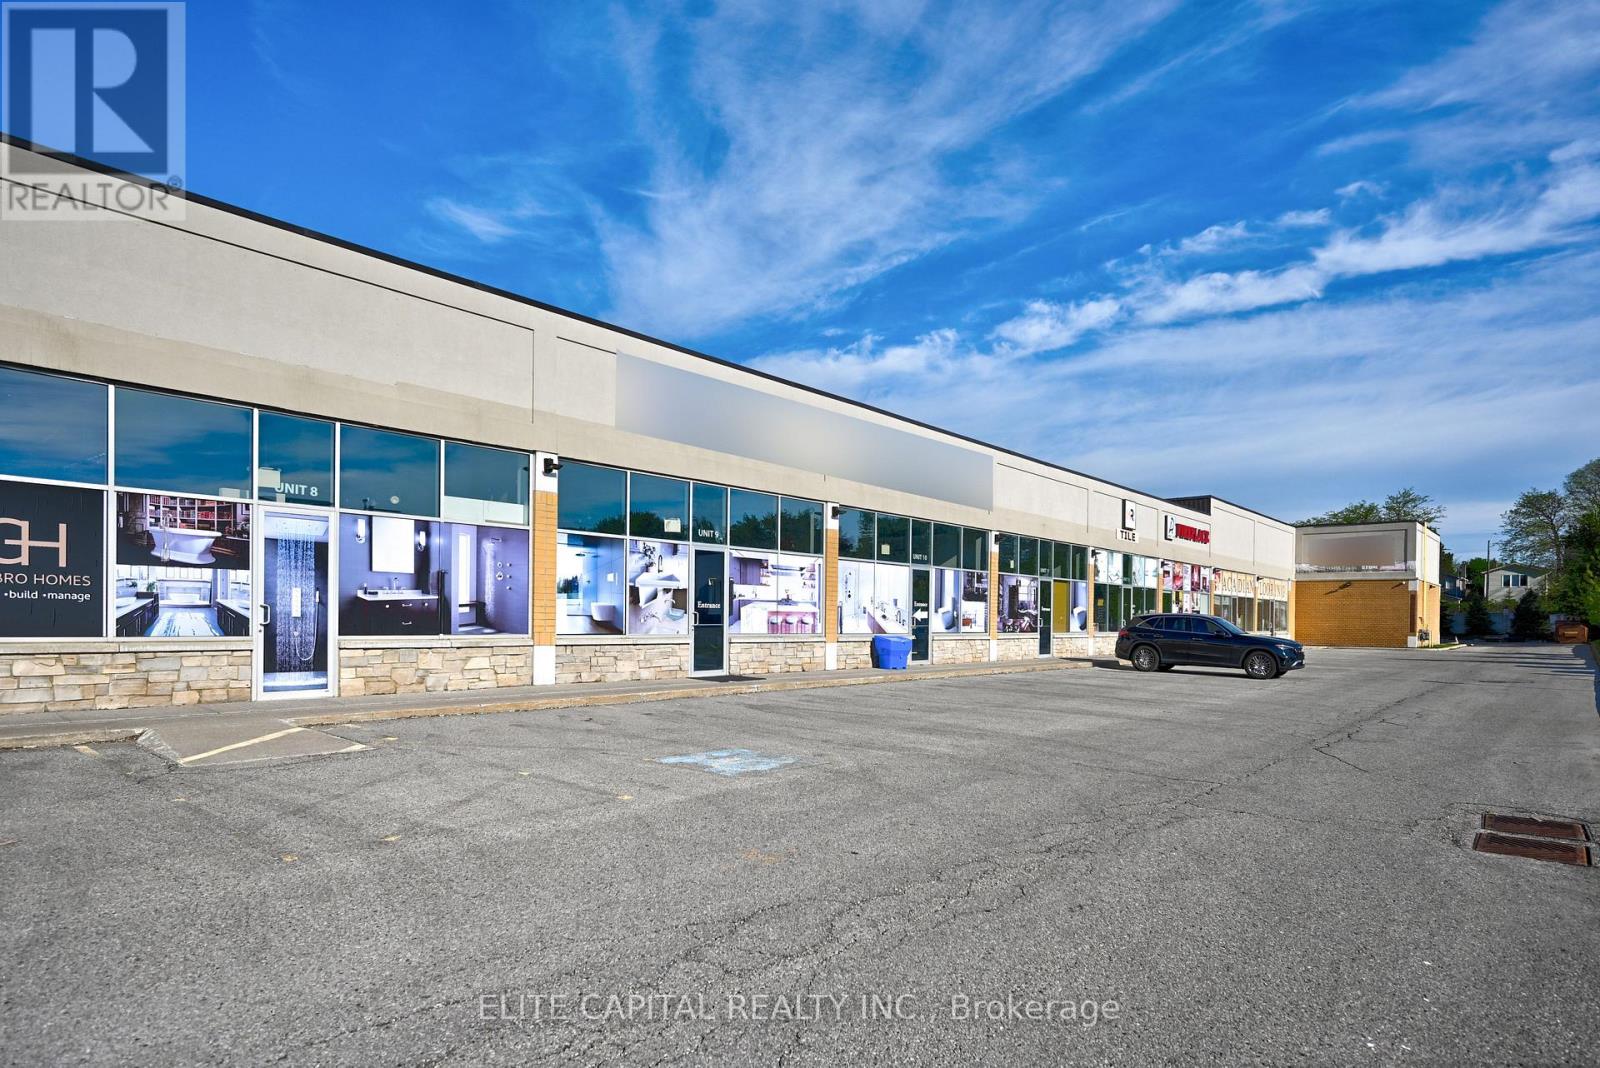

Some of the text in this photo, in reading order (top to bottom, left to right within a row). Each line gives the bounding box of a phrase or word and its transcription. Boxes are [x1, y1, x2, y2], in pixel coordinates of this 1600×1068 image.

[275, 482, 318, 497] UNIT 8
[698, 528, 714, 538] UNIT
[1120, 530, 1136, 542] TILE
[33, 573, 91, 587] HOMES
[697, 600, 721, 609] Entrance
